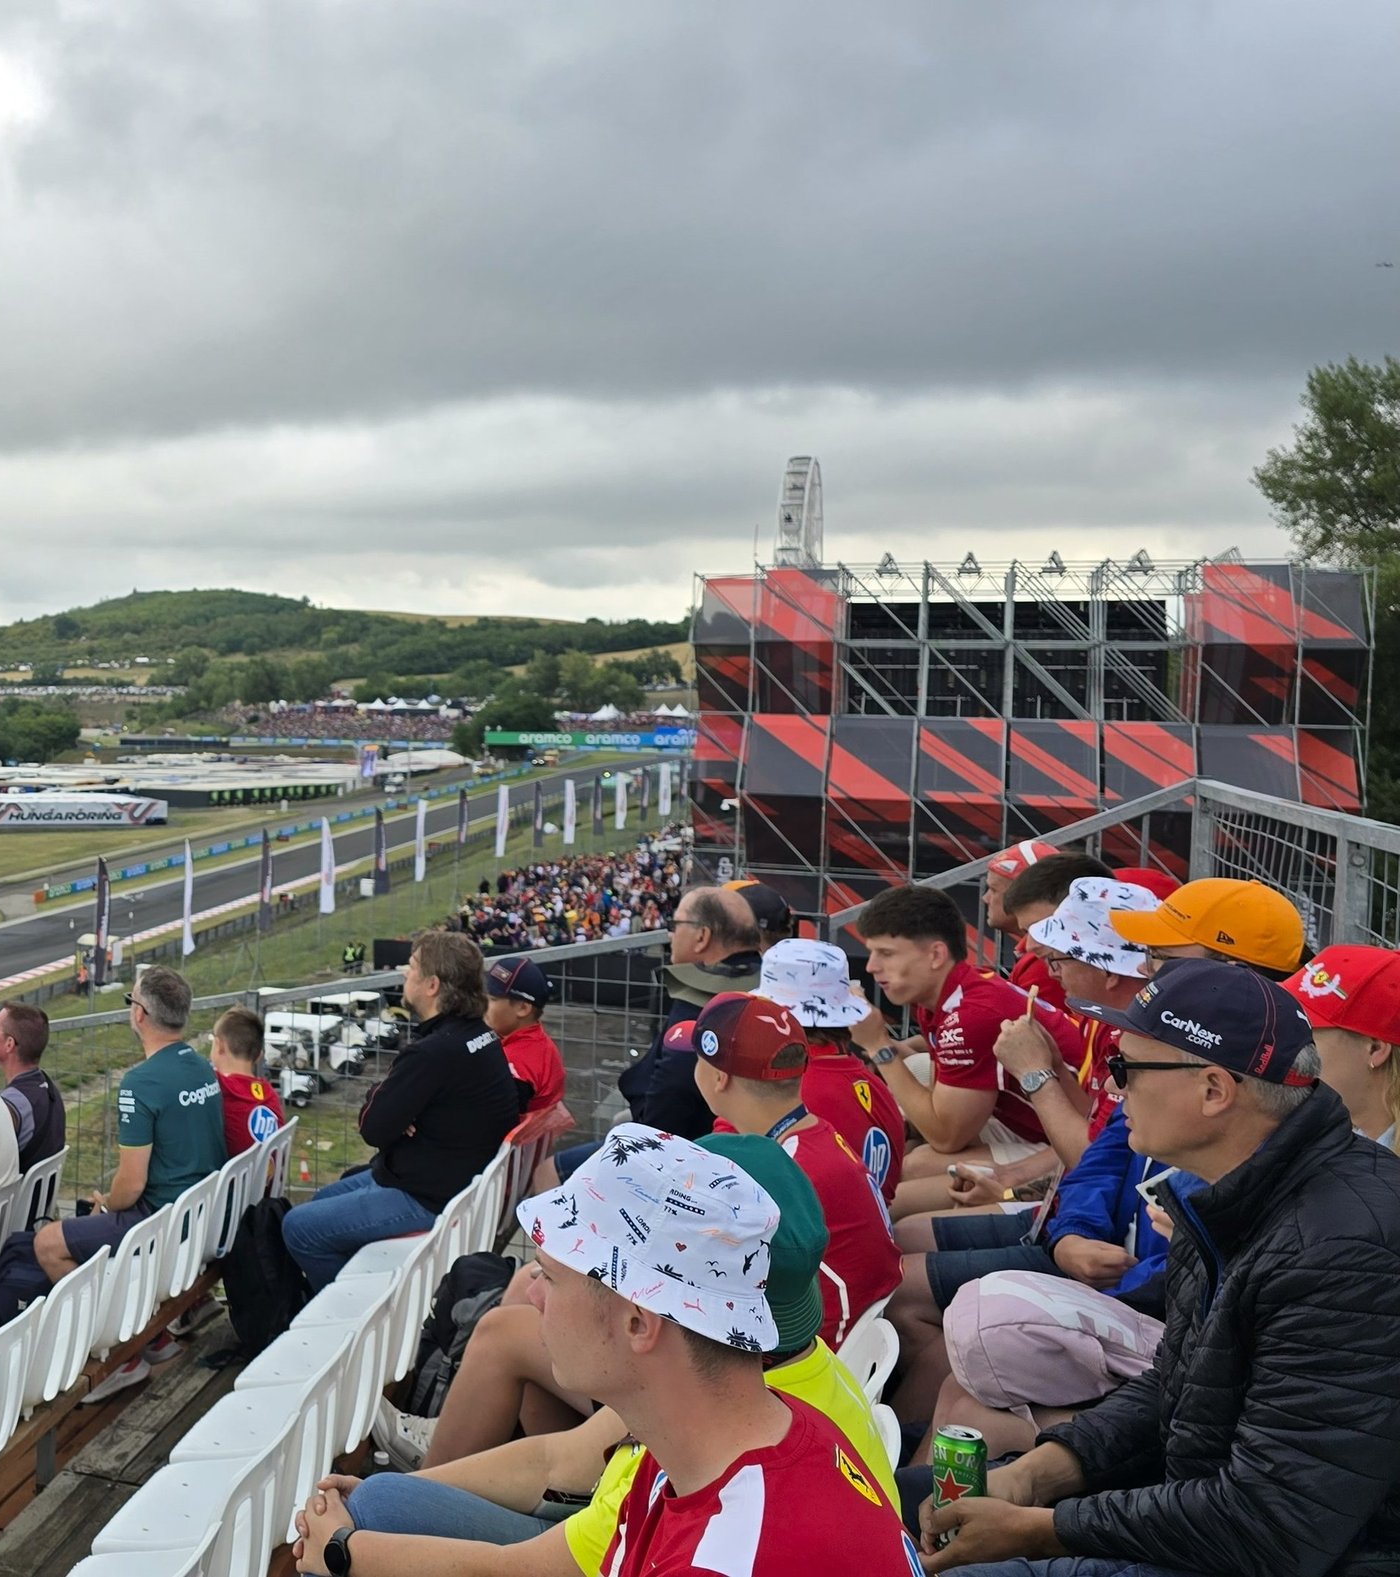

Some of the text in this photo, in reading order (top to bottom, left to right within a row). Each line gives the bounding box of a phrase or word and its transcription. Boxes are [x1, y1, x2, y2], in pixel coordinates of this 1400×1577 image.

[518, 733, 572, 745] aramco
[585, 733, 641, 745] aramco
[1161, 1010, 1223, 1046] CarNext
[1185, 1034, 1212, 1050] .com
[254, 1108, 276, 1140] hp
